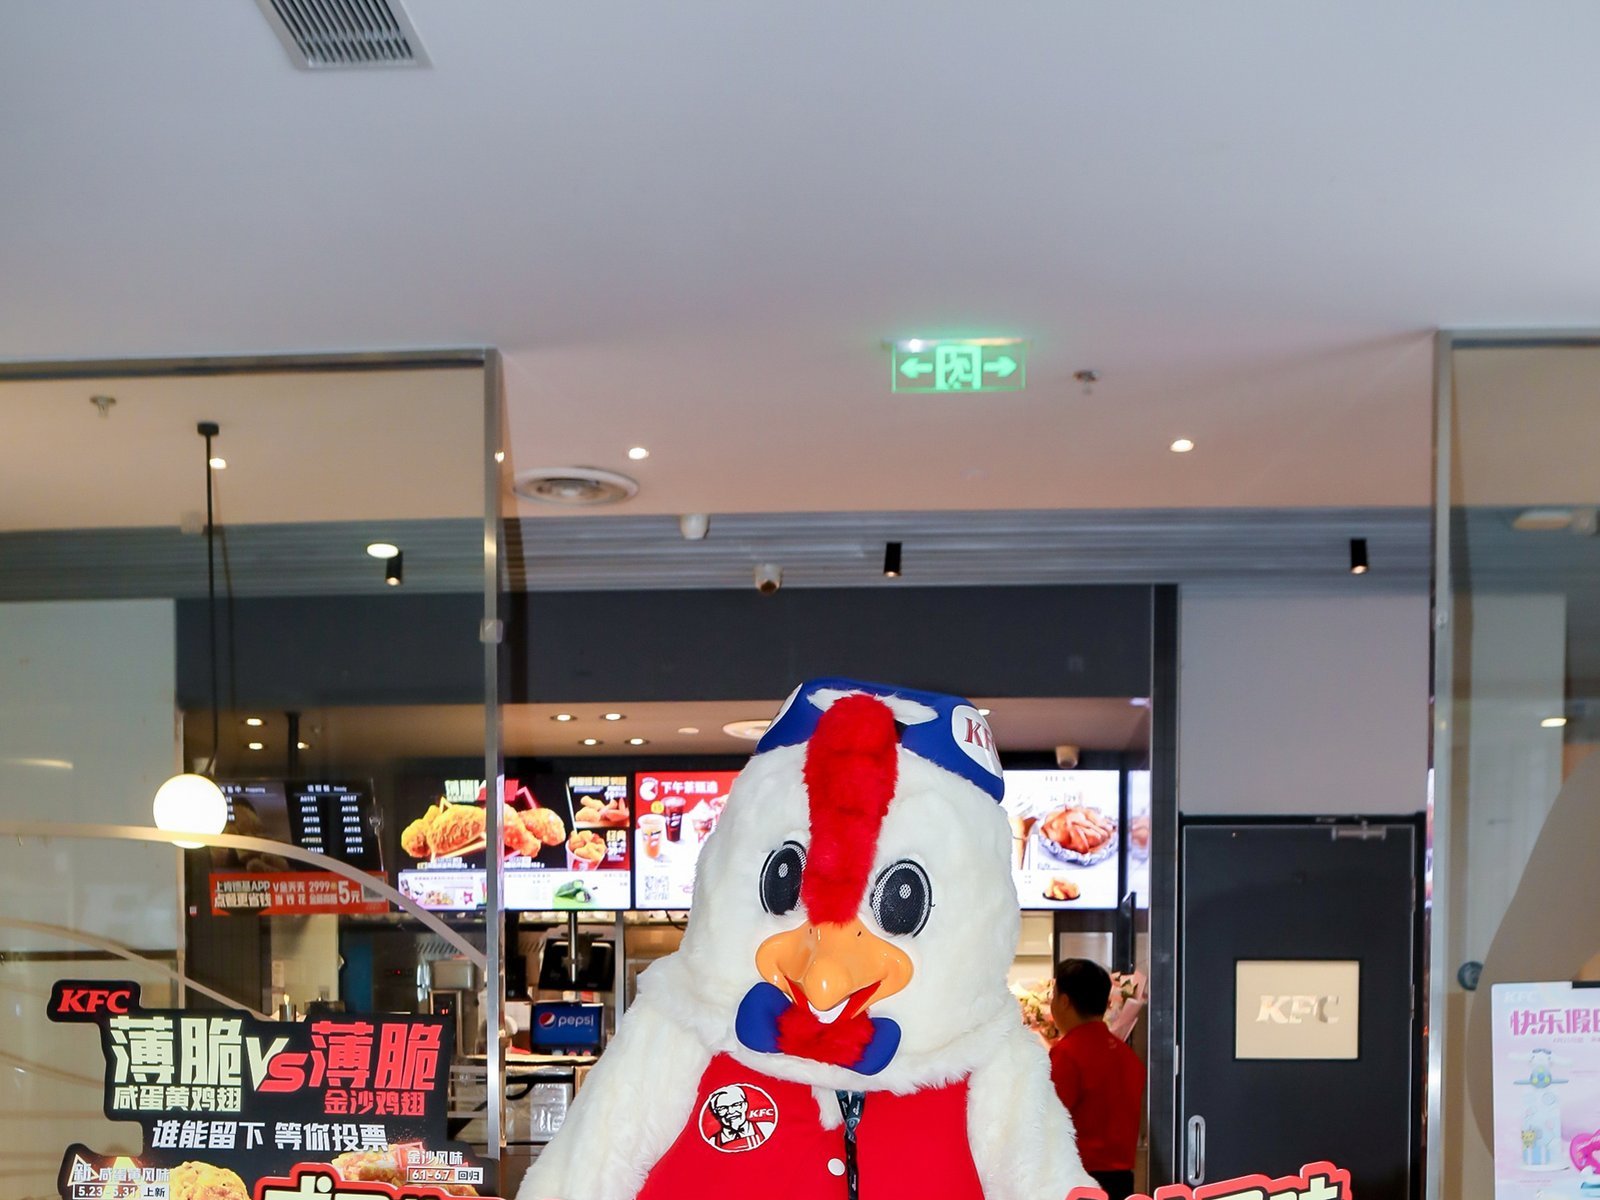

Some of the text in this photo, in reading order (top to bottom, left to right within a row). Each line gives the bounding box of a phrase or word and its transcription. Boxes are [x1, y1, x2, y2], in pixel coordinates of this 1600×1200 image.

[57, 988, 131, 1014] KFC
[1255, 995, 1340, 1024] KFC
[558, 1014, 594, 1028] pepsi
[110, 1016, 242, 1086] 薄脆
[309, 1021, 443, 1091] 薄脆
[113, 1086, 242, 1113] 咸蛋黄鸡翅
[324, 1089, 425, 1117] 金沙鸡翅
[749, 1108, 774, 1118] KFC
[152, 1120, 389, 1152] 谁能留下 等你投票
[407, 1150, 463, 1165] 金沙风味
[411, 1170, 480, 1181] 6.1-6.7 回归
[143, 1187, 166, 1198] 上新
